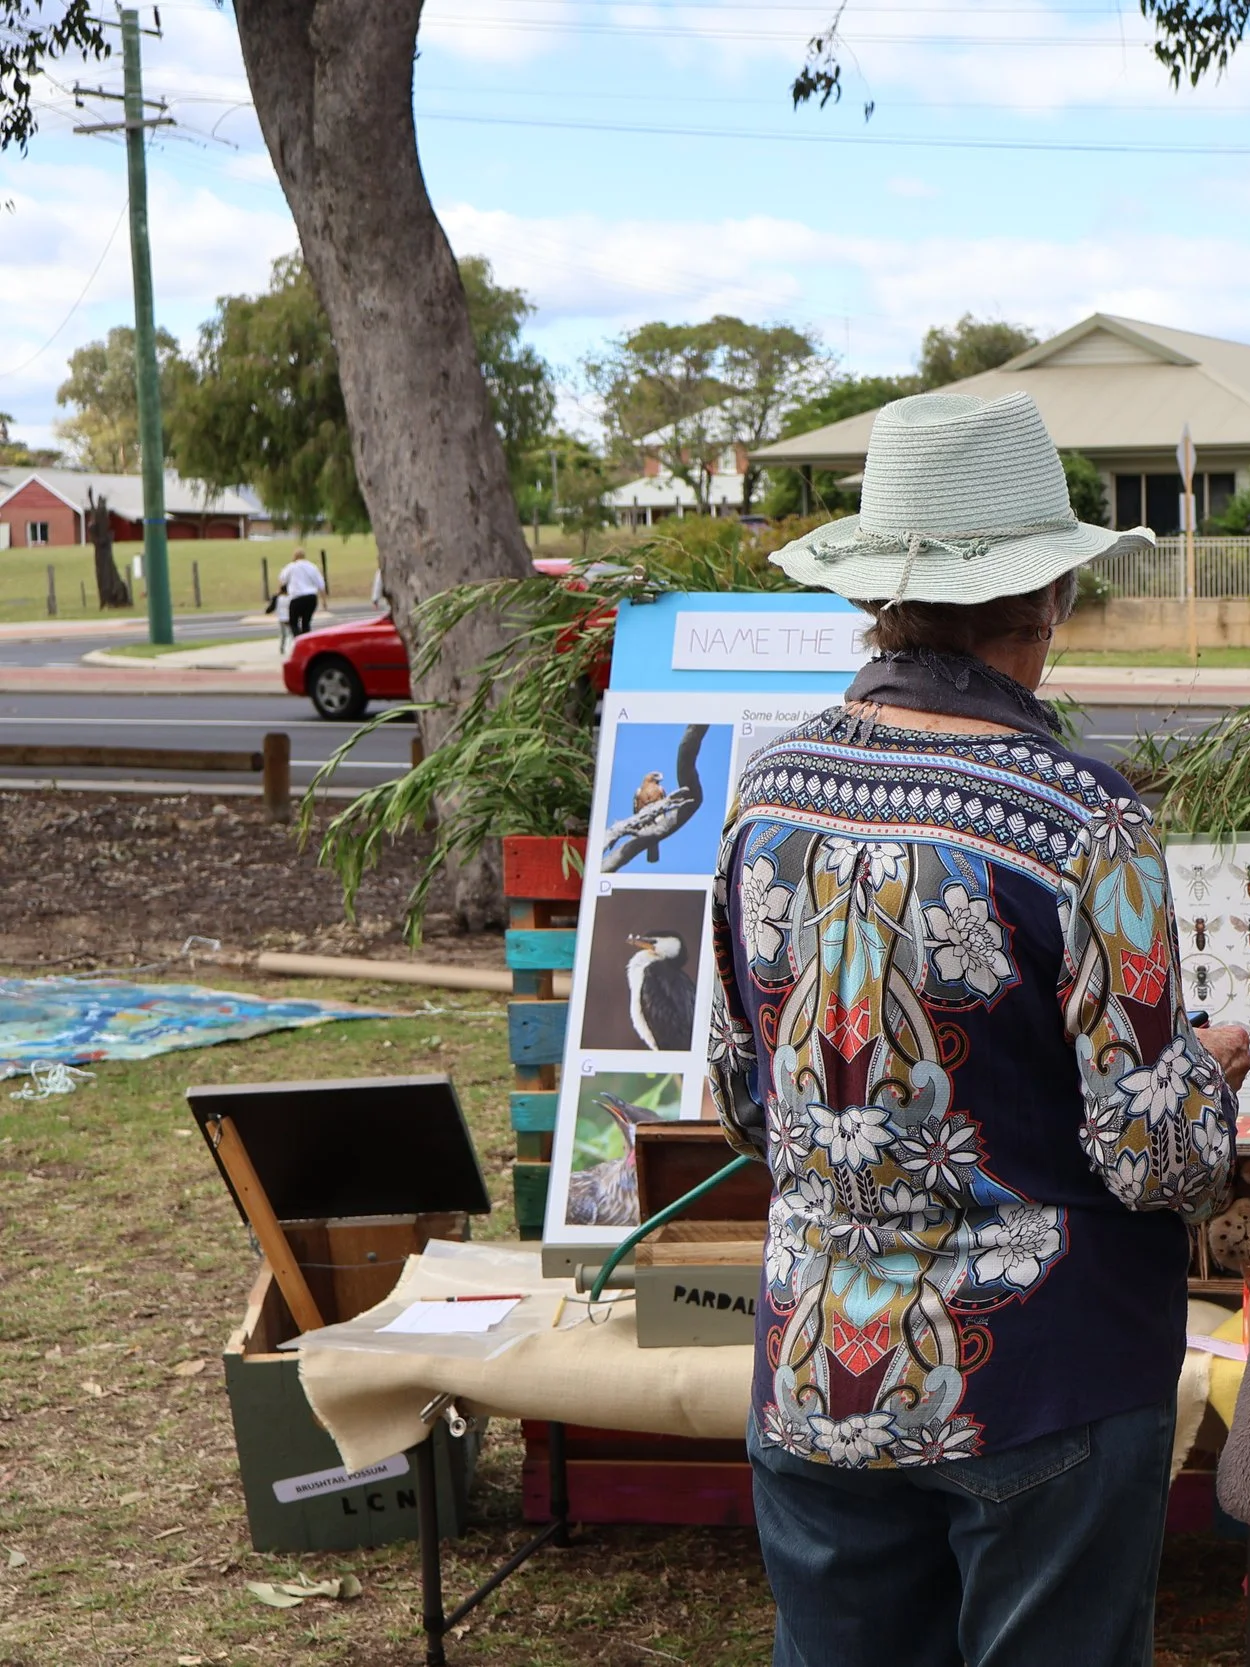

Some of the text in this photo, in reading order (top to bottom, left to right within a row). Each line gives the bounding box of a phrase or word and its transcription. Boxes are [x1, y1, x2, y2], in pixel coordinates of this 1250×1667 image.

[690, 628, 770, 655] NAME
[778, 629, 835, 655] THE
[618, 707, 629, 720] A
[742, 709, 772, 721] Some
[775, 710, 801, 721] local
[742, 722, 753, 735] B
[600, 880, 611, 893] D
[581, 1058, 595, 1074] G
[673, 1285, 756, 1316] PARDAL
[295, 1465, 389, 1493] BRUSHTAIL POSSUM
